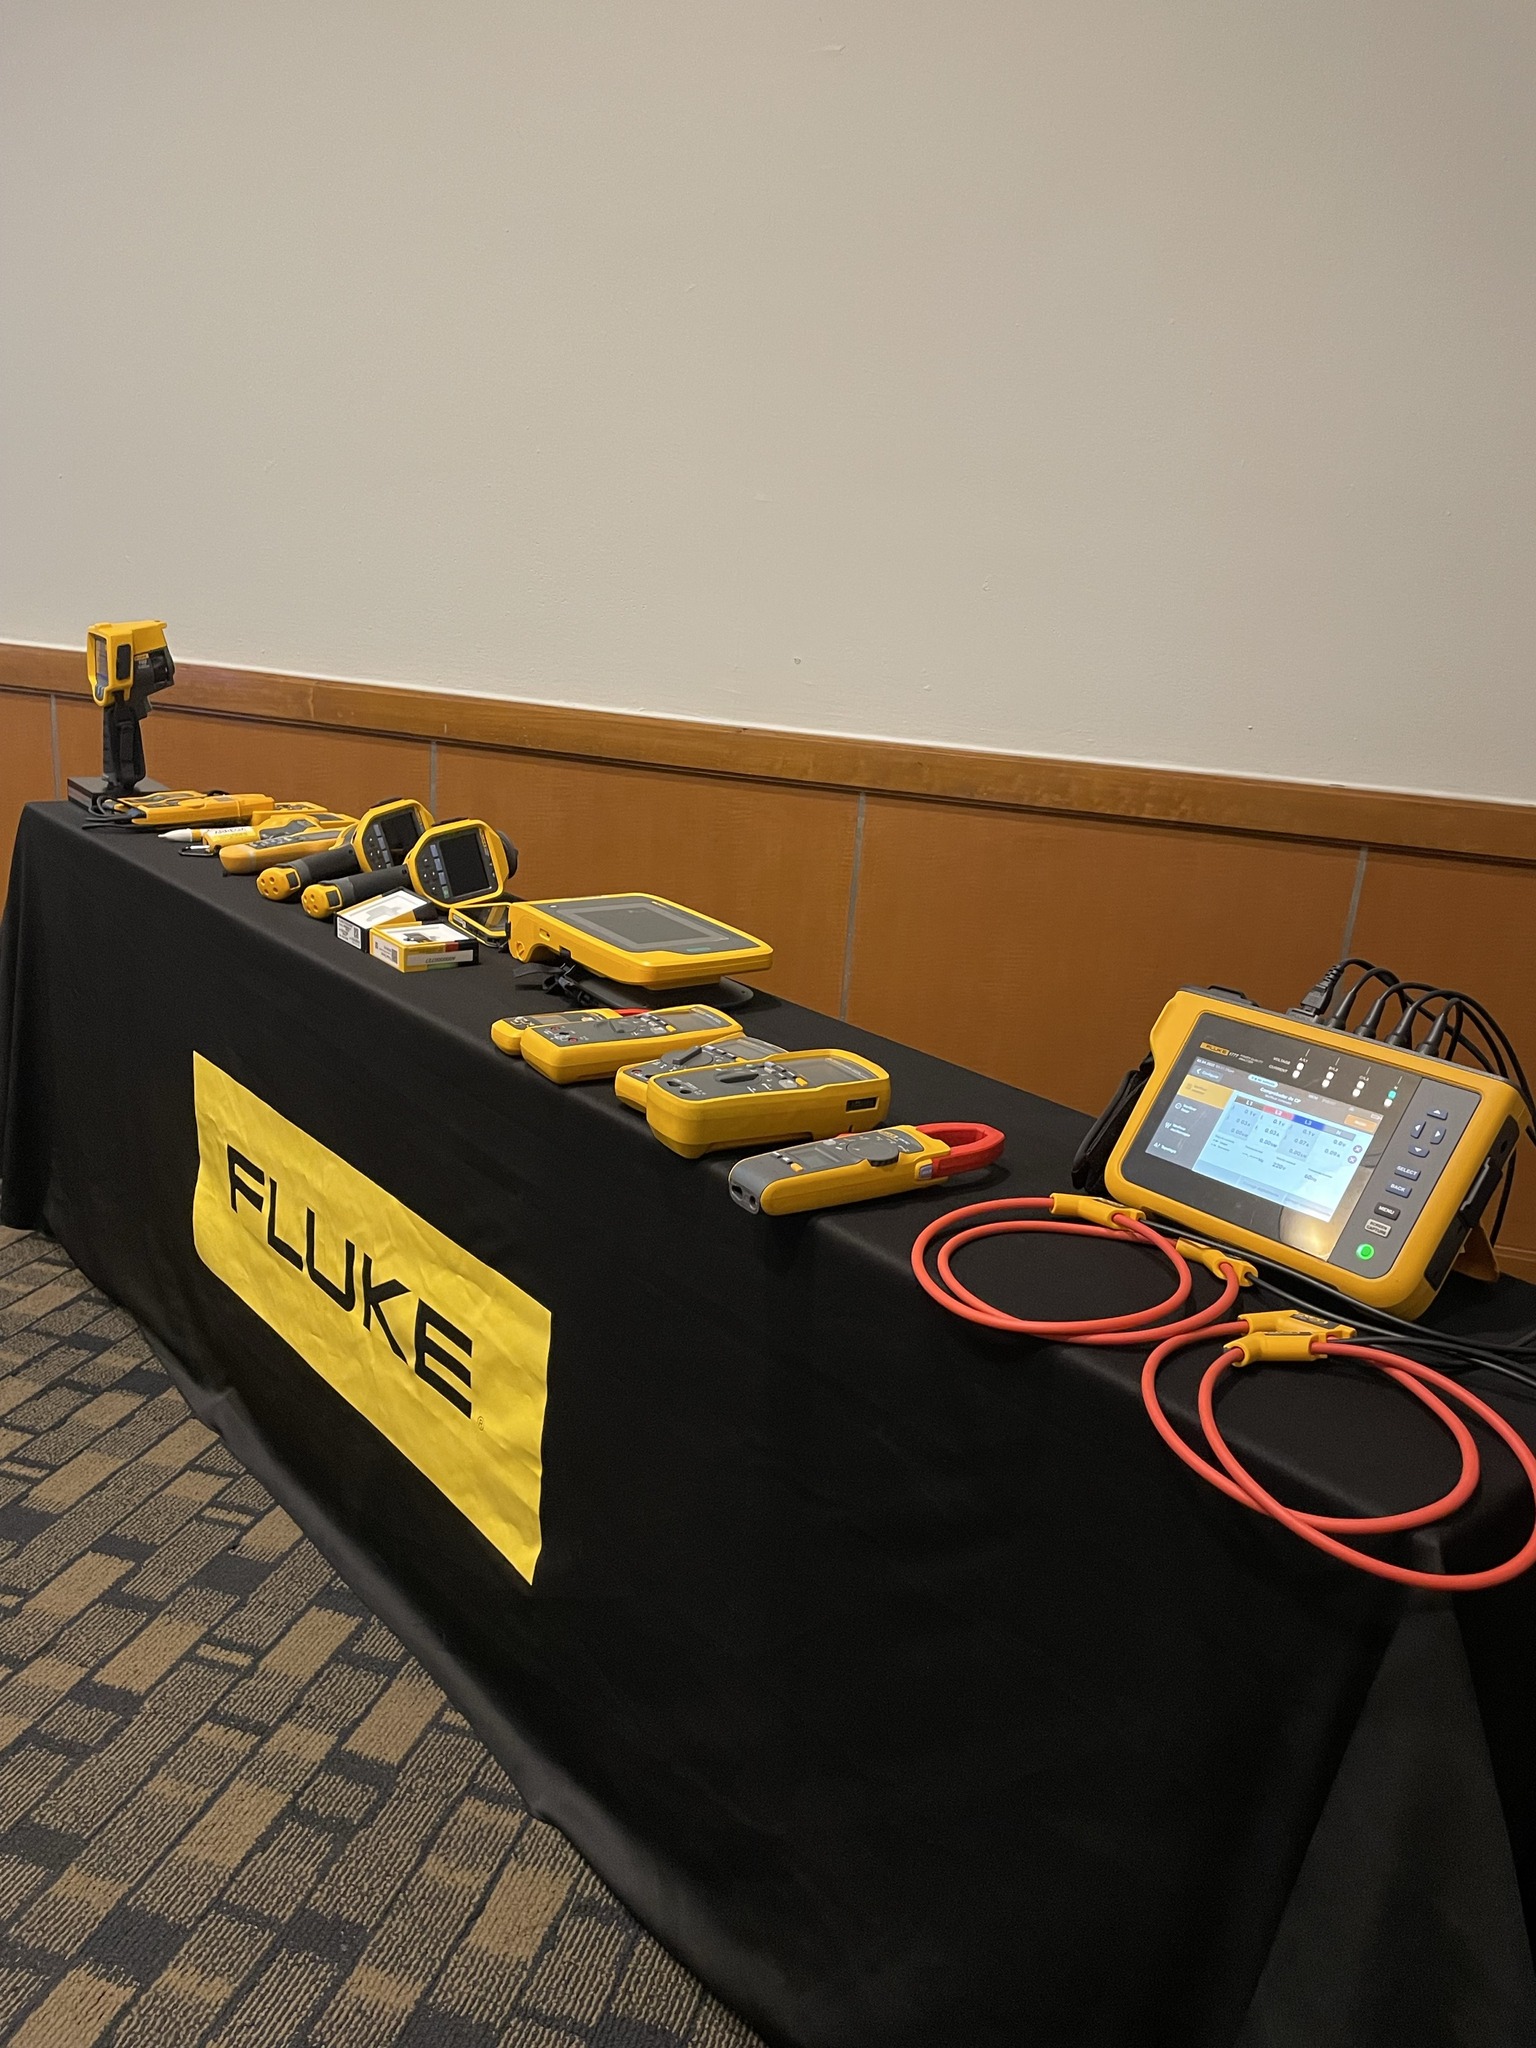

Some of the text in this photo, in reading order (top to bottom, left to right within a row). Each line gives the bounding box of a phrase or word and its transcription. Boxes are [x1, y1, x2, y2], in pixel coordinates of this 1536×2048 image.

[1396, 1165, 1417, 1175] SELECT
[1390, 1183, 1406, 1192] BACK
[1378, 1205, 1395, 1214] MENU
[1365, 1224, 1386, 1235] CAPTURE
[1369, 1221, 1387, 1230] SCREEN
[227, 1144, 473, 1420] FLUKE
